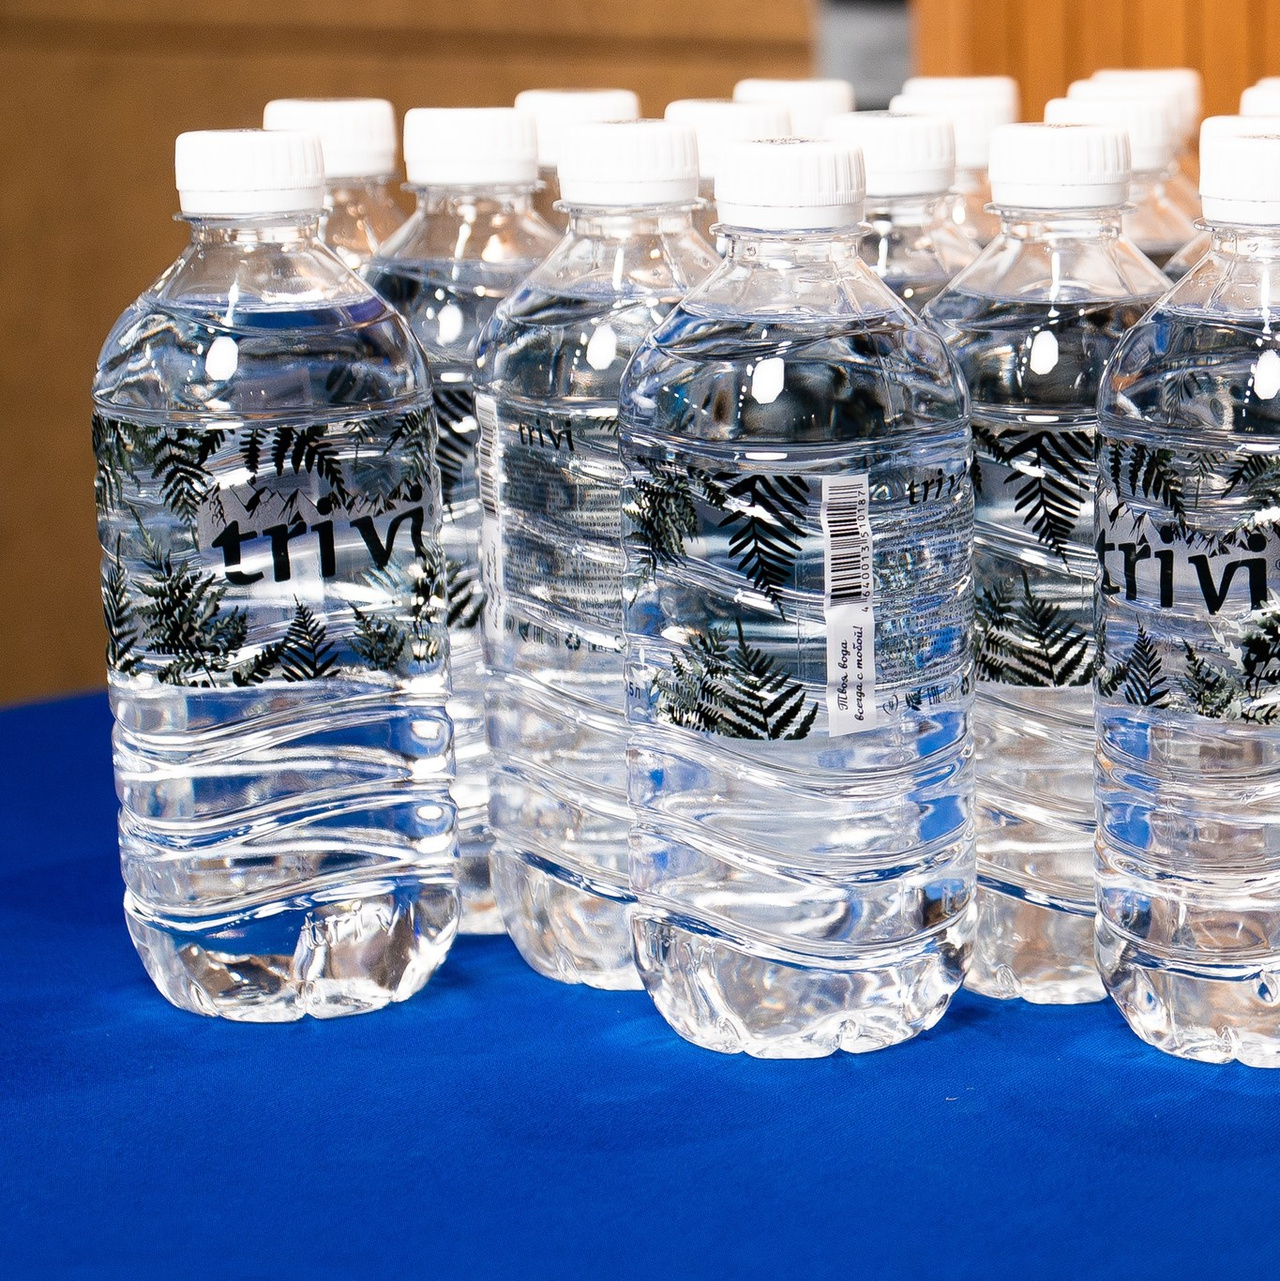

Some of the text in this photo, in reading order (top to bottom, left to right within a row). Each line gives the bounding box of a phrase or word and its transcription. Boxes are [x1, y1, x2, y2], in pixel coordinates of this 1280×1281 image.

[520, 419, 575, 452] trivi
[211, 483, 426, 586] trivi
[1095, 526, 1268, 615] trivi
[837, 639, 850, 711] Твоя вода
[853, 625, 866, 721] всегда с тобой!
